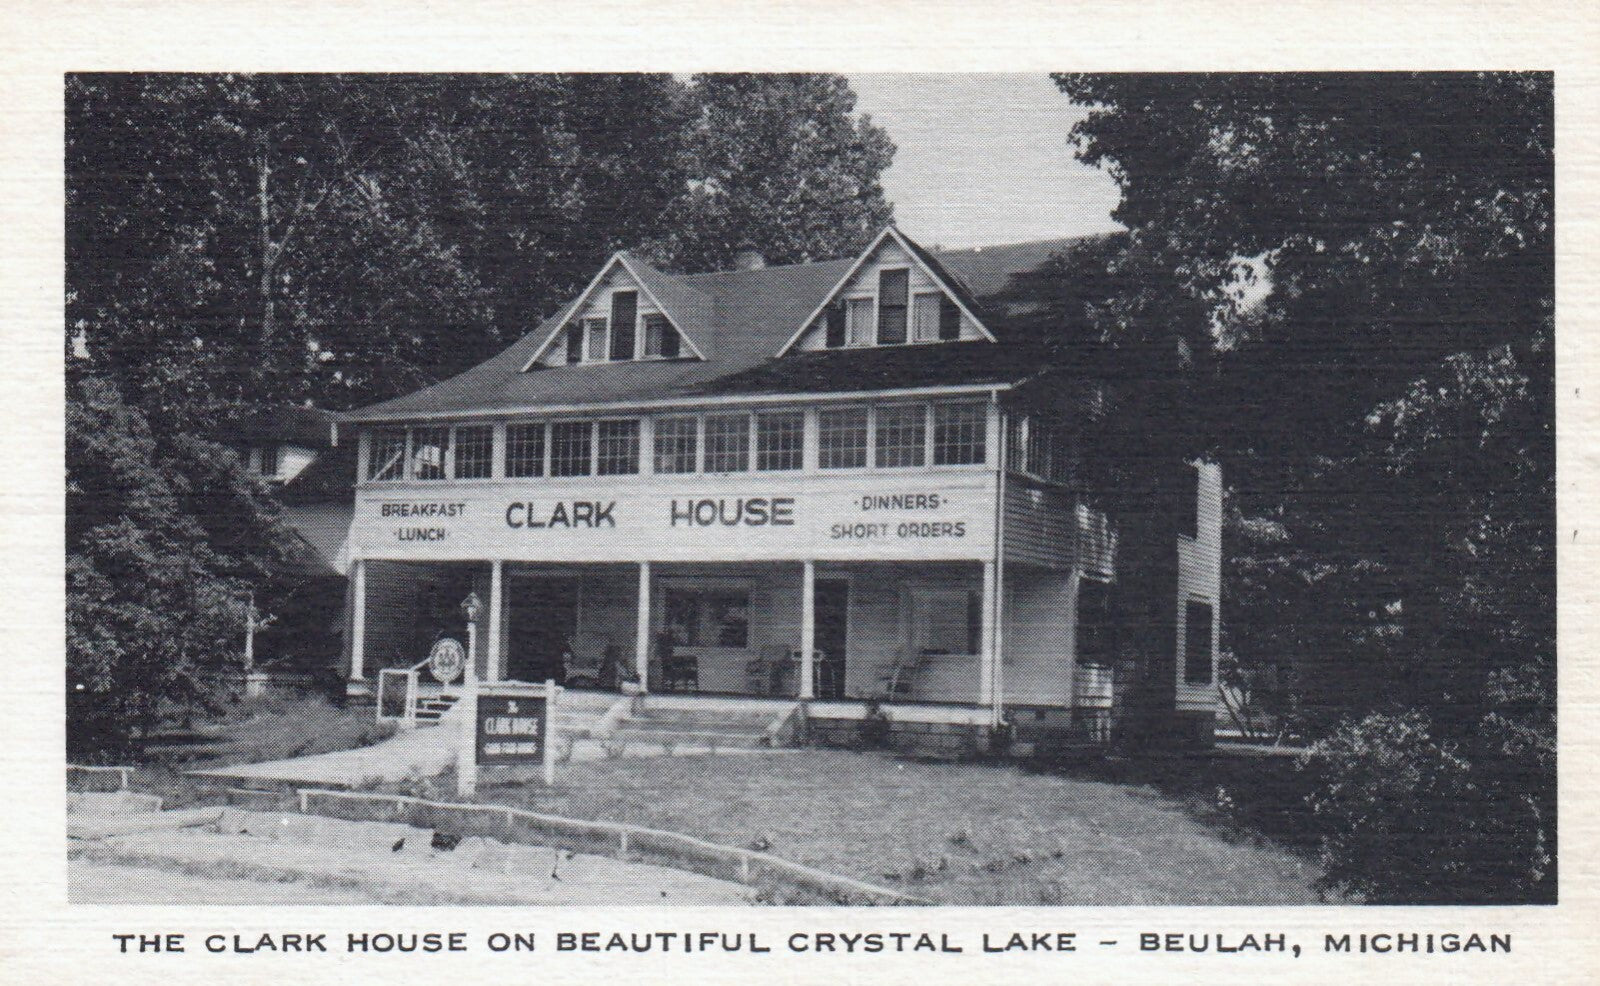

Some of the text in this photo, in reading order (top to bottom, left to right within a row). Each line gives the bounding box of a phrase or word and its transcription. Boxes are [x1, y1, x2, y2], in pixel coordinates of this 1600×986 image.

[381, 503, 465, 517] BREAKFAST
[862, 494, 940, 511] DINNERS
[505, 498, 795, 529] CLARK HOUSE
[398, 528, 446, 541] LUNCH
[831, 522, 966, 539] SHORT ORDERS
